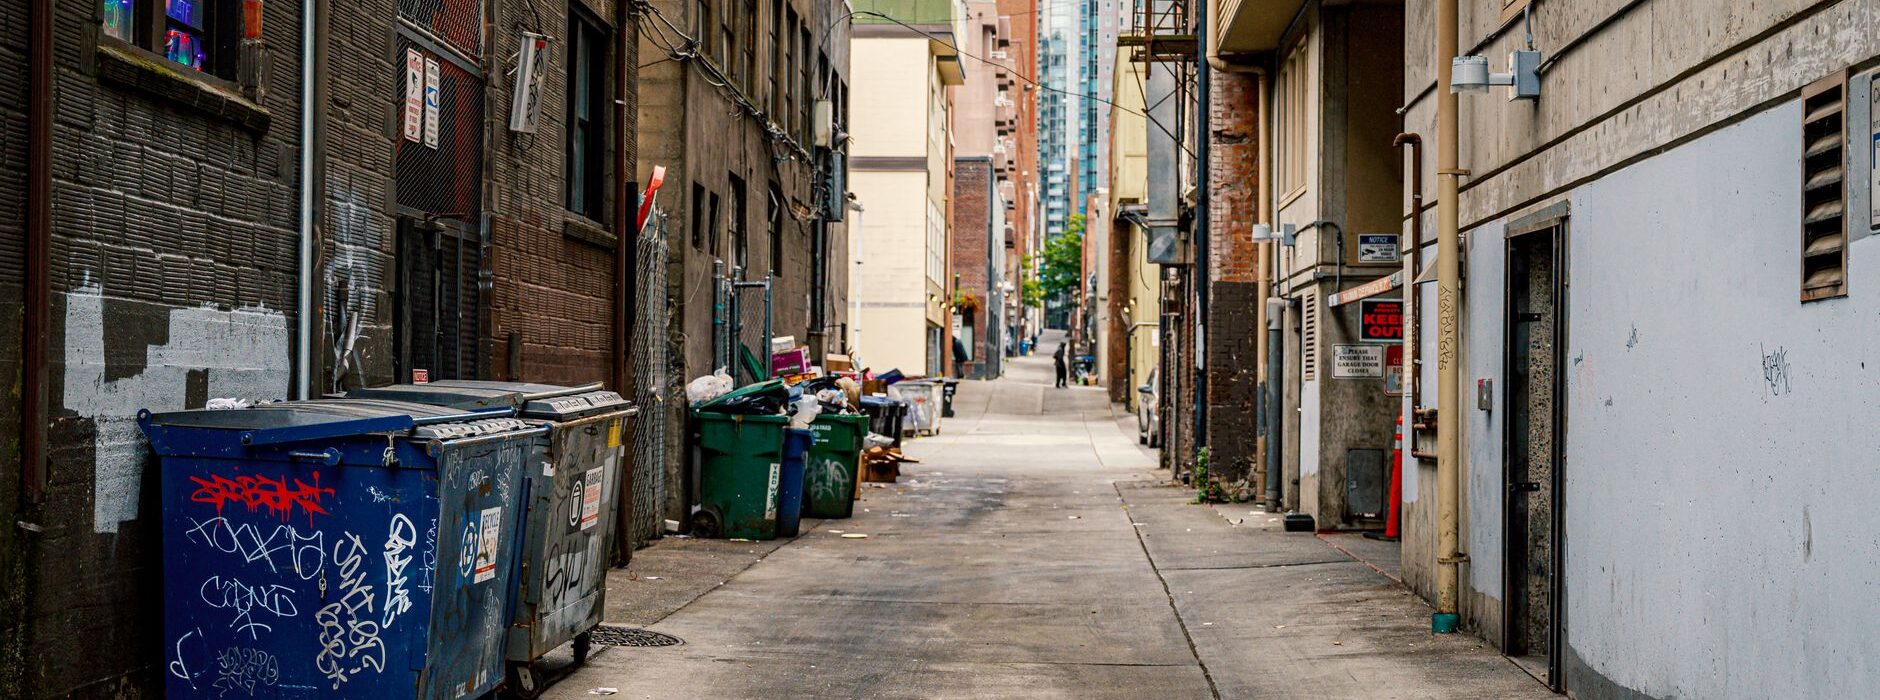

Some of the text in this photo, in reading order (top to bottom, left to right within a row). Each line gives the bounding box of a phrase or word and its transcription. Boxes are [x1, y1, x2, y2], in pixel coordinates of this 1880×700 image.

[1369, 326, 1403, 337] OUT
[586, 470, 602, 486] GARBAGE
[483, 512, 500, 530] RECYCLE
